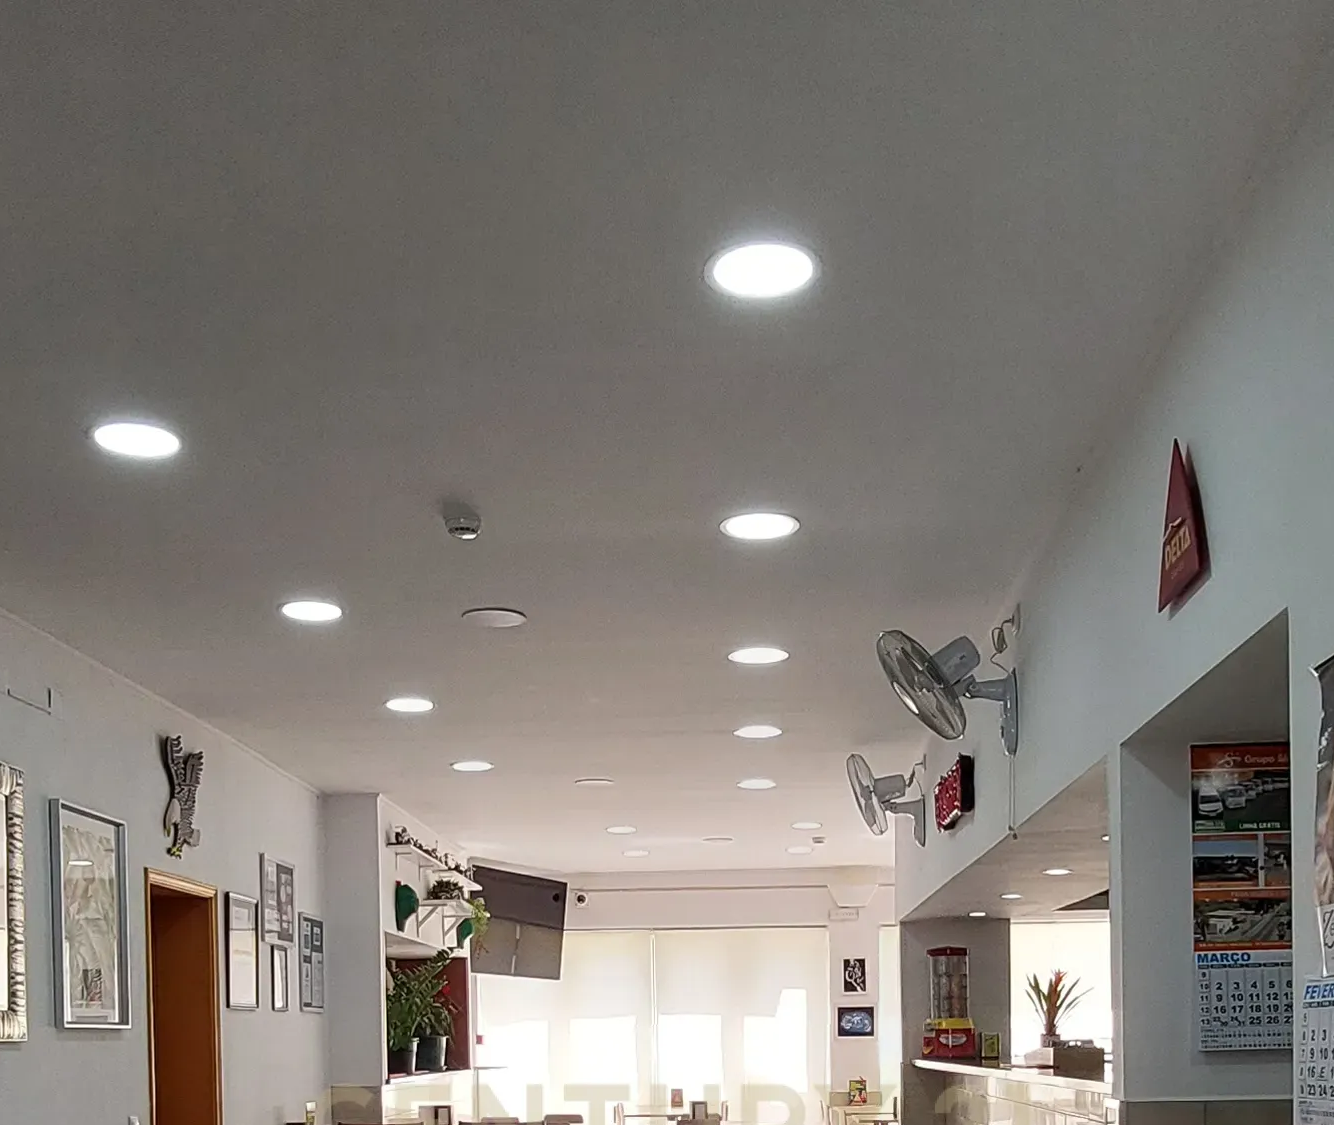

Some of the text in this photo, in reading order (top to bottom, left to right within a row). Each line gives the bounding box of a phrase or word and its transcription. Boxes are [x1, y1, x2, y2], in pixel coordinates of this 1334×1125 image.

[1165, 525, 1192, 570] DELTA
[1197, 952, 1251, 964] MARÇO
[1216, 982, 1222, 990] 2
[1251, 981, 1257, 989] 4
[1216, 994, 1222, 1002] 9
[1249, 993, 1260, 1001] 11
[1214, 1006, 1226, 1014] 16
[1267, 1016, 1279, 1024] 26
[1311, 1030, 1315, 1041] 2
[1322, 1030, 1326, 1041] 3
[1310, 1048, 1314, 1059] 9
[1320, 1048, 1328, 1059] 10
[1307, 1066, 1315, 1078] 16
[1307, 1085, 1316, 1096] 23
[1319, 1085, 1327, 1096] 24
